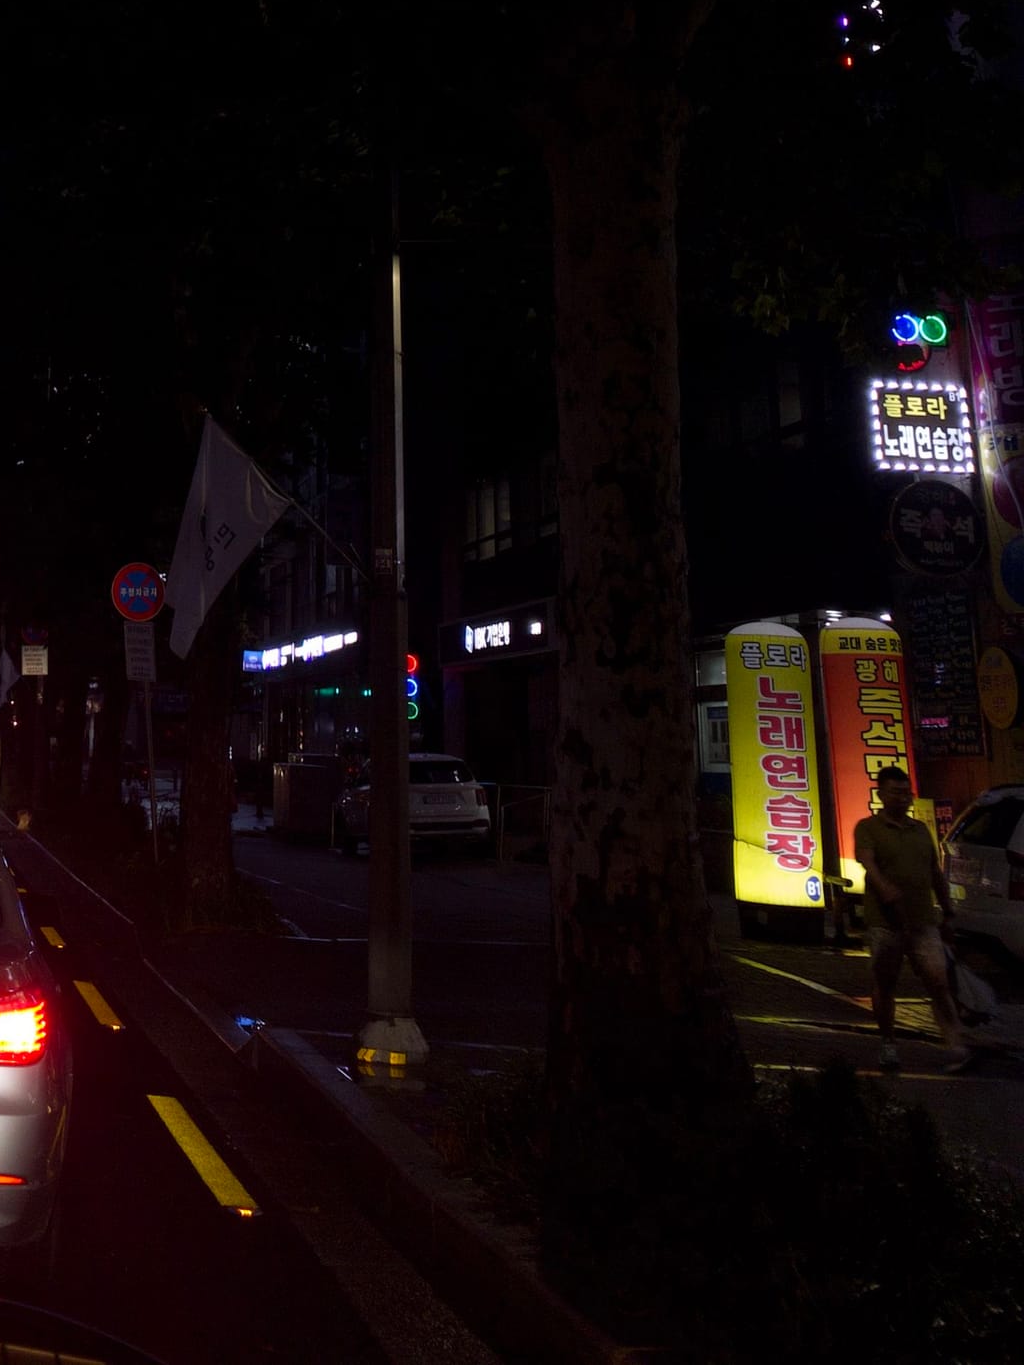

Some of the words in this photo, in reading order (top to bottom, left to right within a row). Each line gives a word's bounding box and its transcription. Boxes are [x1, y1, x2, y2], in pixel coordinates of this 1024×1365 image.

[883, 394, 947, 420] 플로라
[883, 424, 964, 461] 노래연습장
[740, 642, 807, 671] 플로라
[839, 637, 861, 650] 교대
[865, 637, 887, 651] 숨은
[854, 659, 899, 684] 광해
[757, 677, 817, 871] 노래연습장
[806, 879, 821, 899] B1
